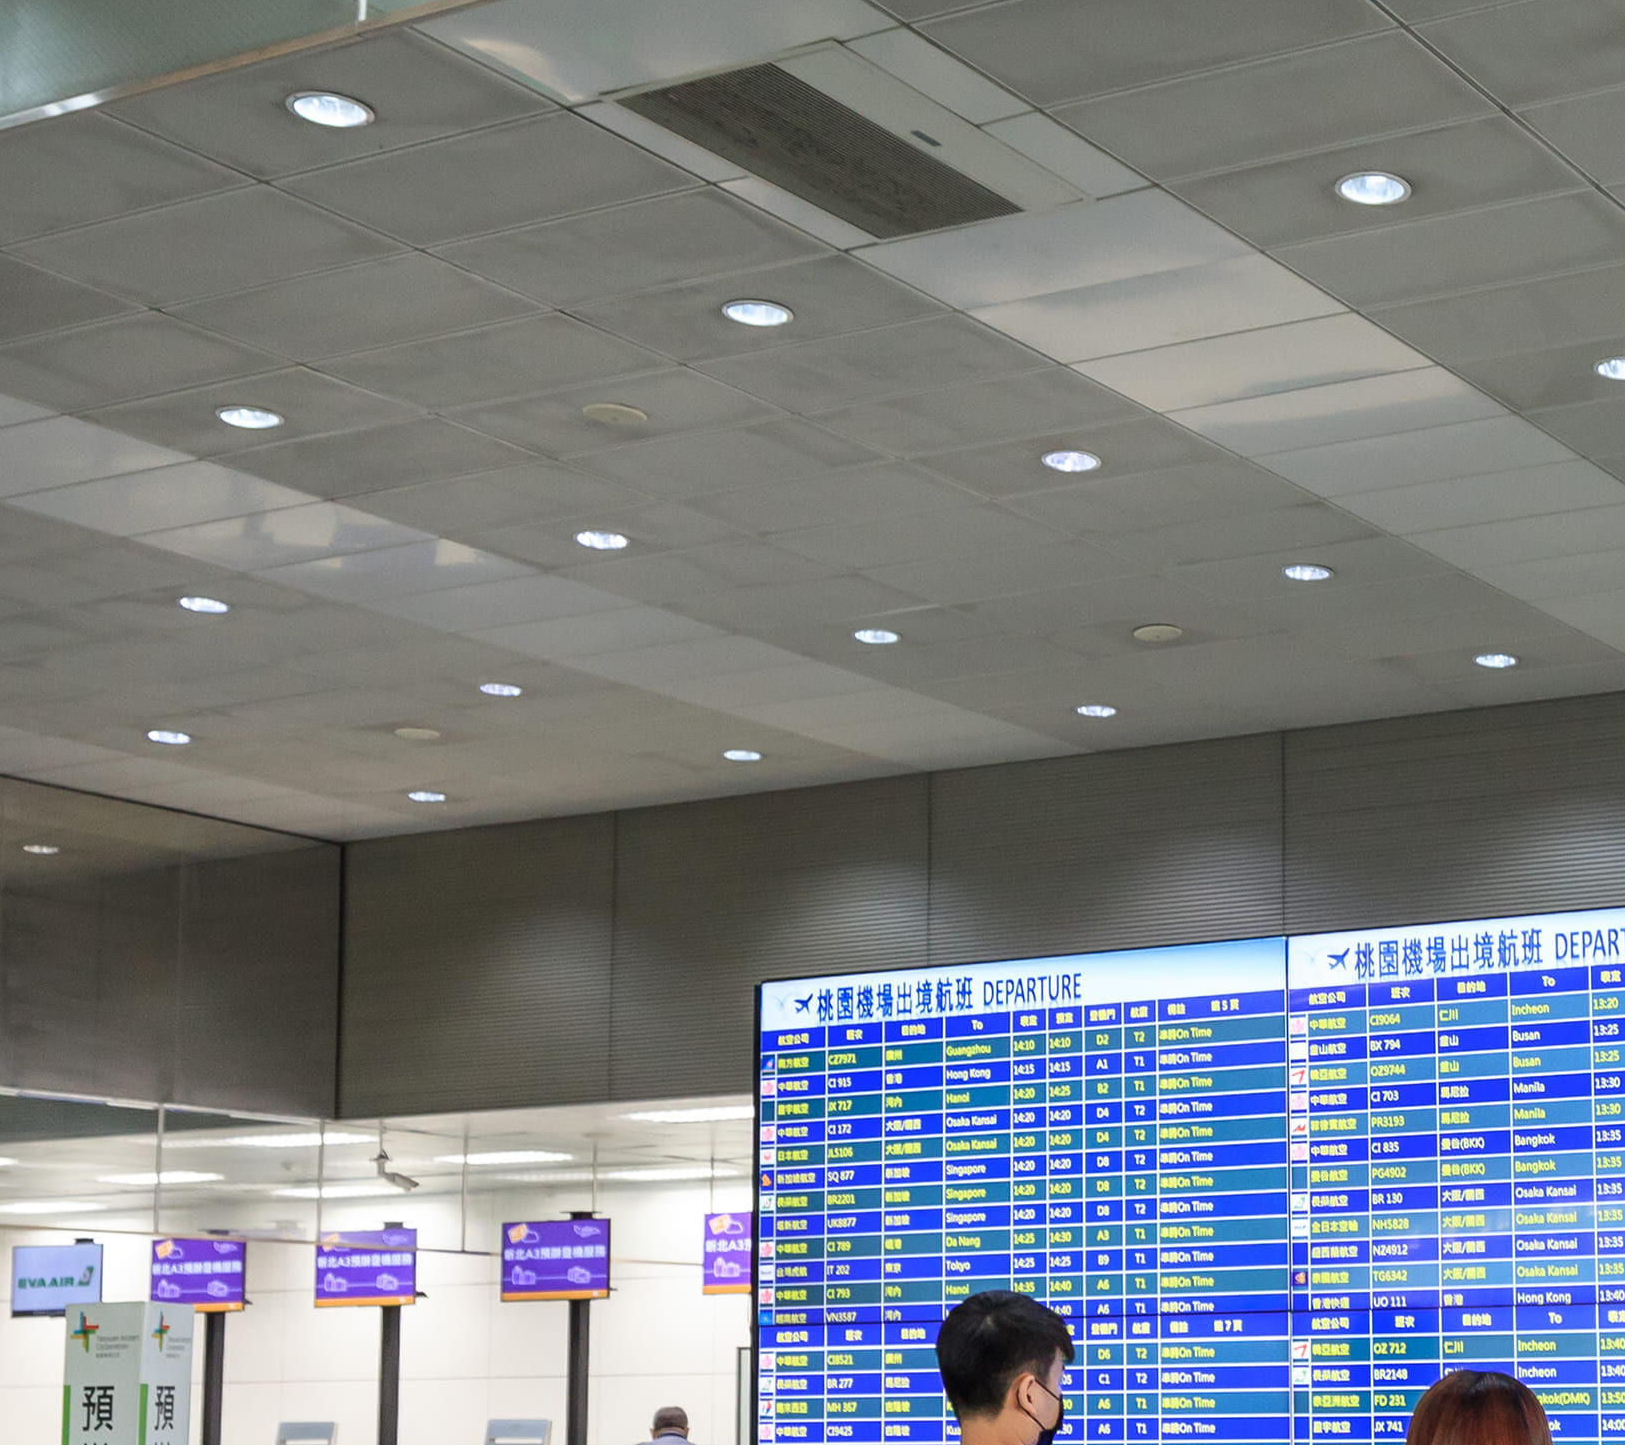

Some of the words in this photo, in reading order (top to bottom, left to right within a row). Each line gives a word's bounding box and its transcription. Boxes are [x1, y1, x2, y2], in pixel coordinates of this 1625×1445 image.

[1354, 927, 1543, 980] 桃園機場出境航班
[816, 975, 974, 1024] 桃園機場出境航班
[983, 972, 1083, 1007] DEPARTURE
[1369, 1011, 1401, 1027] CI9064
[1511, 1001, 1549, 1016] Incheon
[1511, 1028, 1541, 1042] Busan
[945, 1042, 992, 1060] Guangzhou
[1012, 1039, 1035, 1052] 14:10
[945, 1066, 969, 1084] Hong
[970, 1064, 992, 1081] Kong
[1512, 1079, 1546, 1094] Manila
[945, 1091, 971, 1105] Hanoi
[1513, 1132, 1556, 1149] Bangkok
[945, 1161, 987, 1178] Singapore
[1514, 1184, 1544, 1199] Osaka
[1546, 1183, 1578, 1198] Kansai
[18, 1278, 46, 1289] EVA
[48, 1276, 74, 1287] AIR
